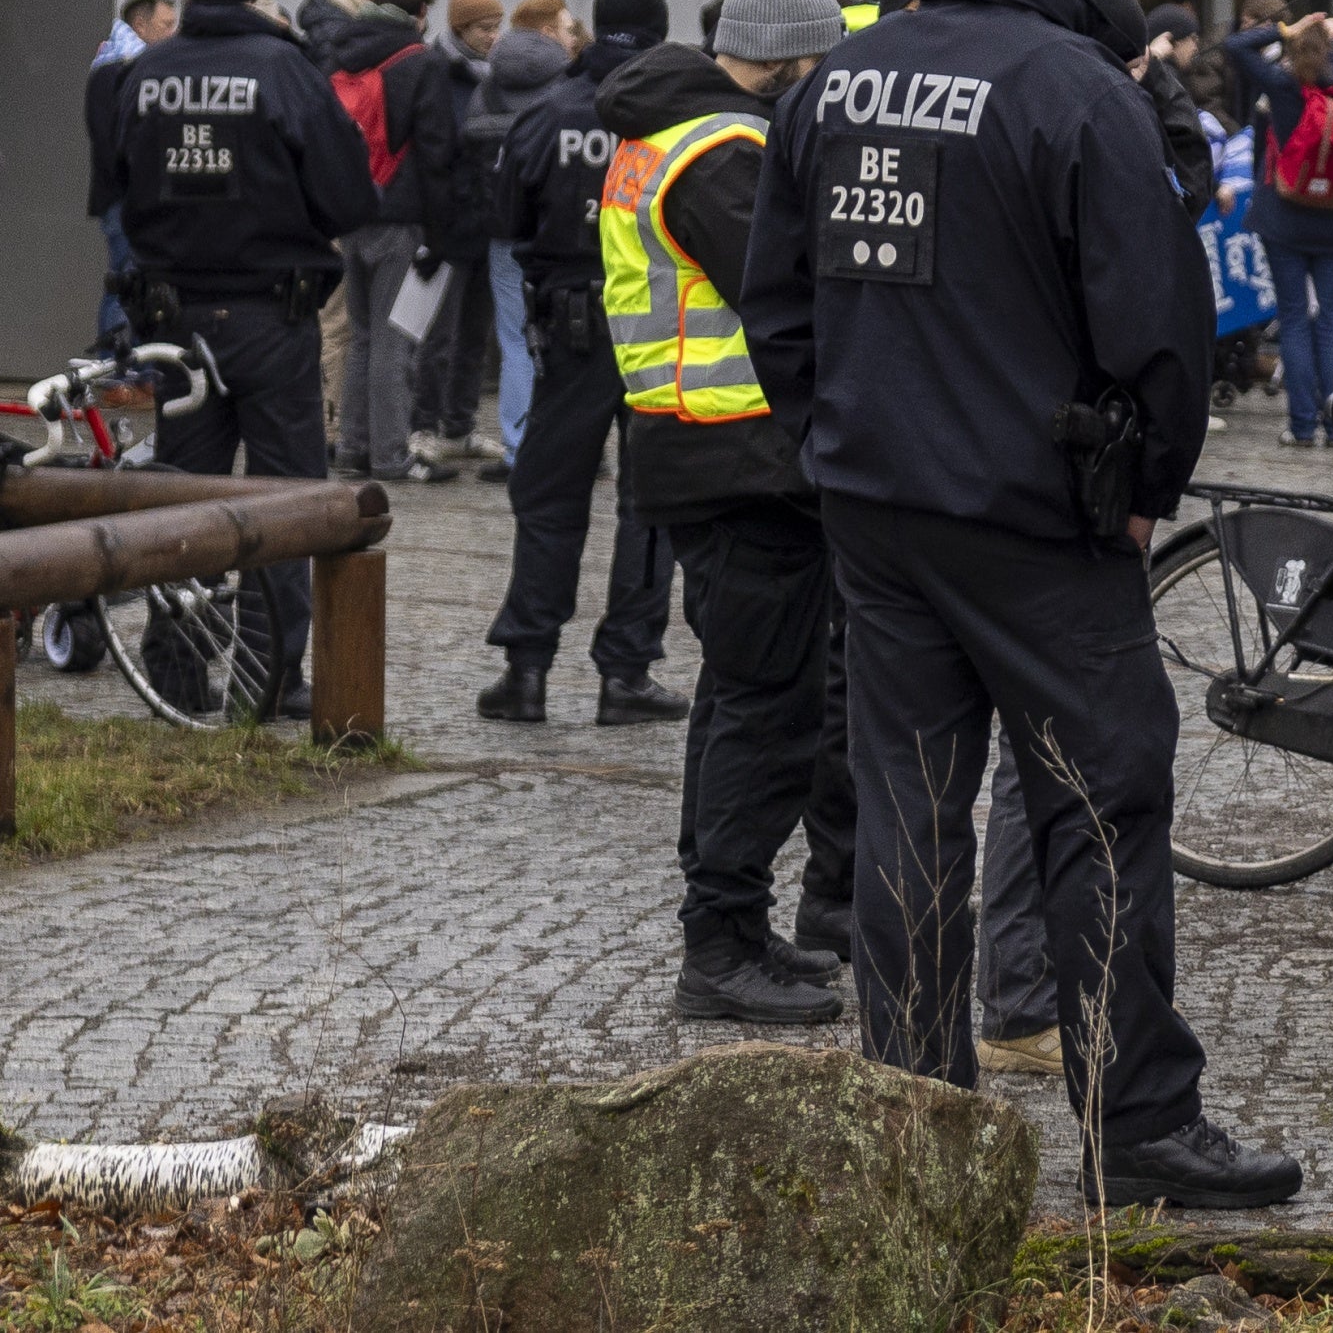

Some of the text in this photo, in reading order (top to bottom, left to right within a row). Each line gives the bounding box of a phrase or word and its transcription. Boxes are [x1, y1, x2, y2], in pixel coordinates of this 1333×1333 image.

[138, 75, 258, 115] POLIZEI
[818, 69, 992, 136] POLIZEI
[182, 124, 213, 147] BE
[165, 147, 233, 174] 22318
[859, 146, 900, 183] BE
[830, 185, 925, 226] 22320
